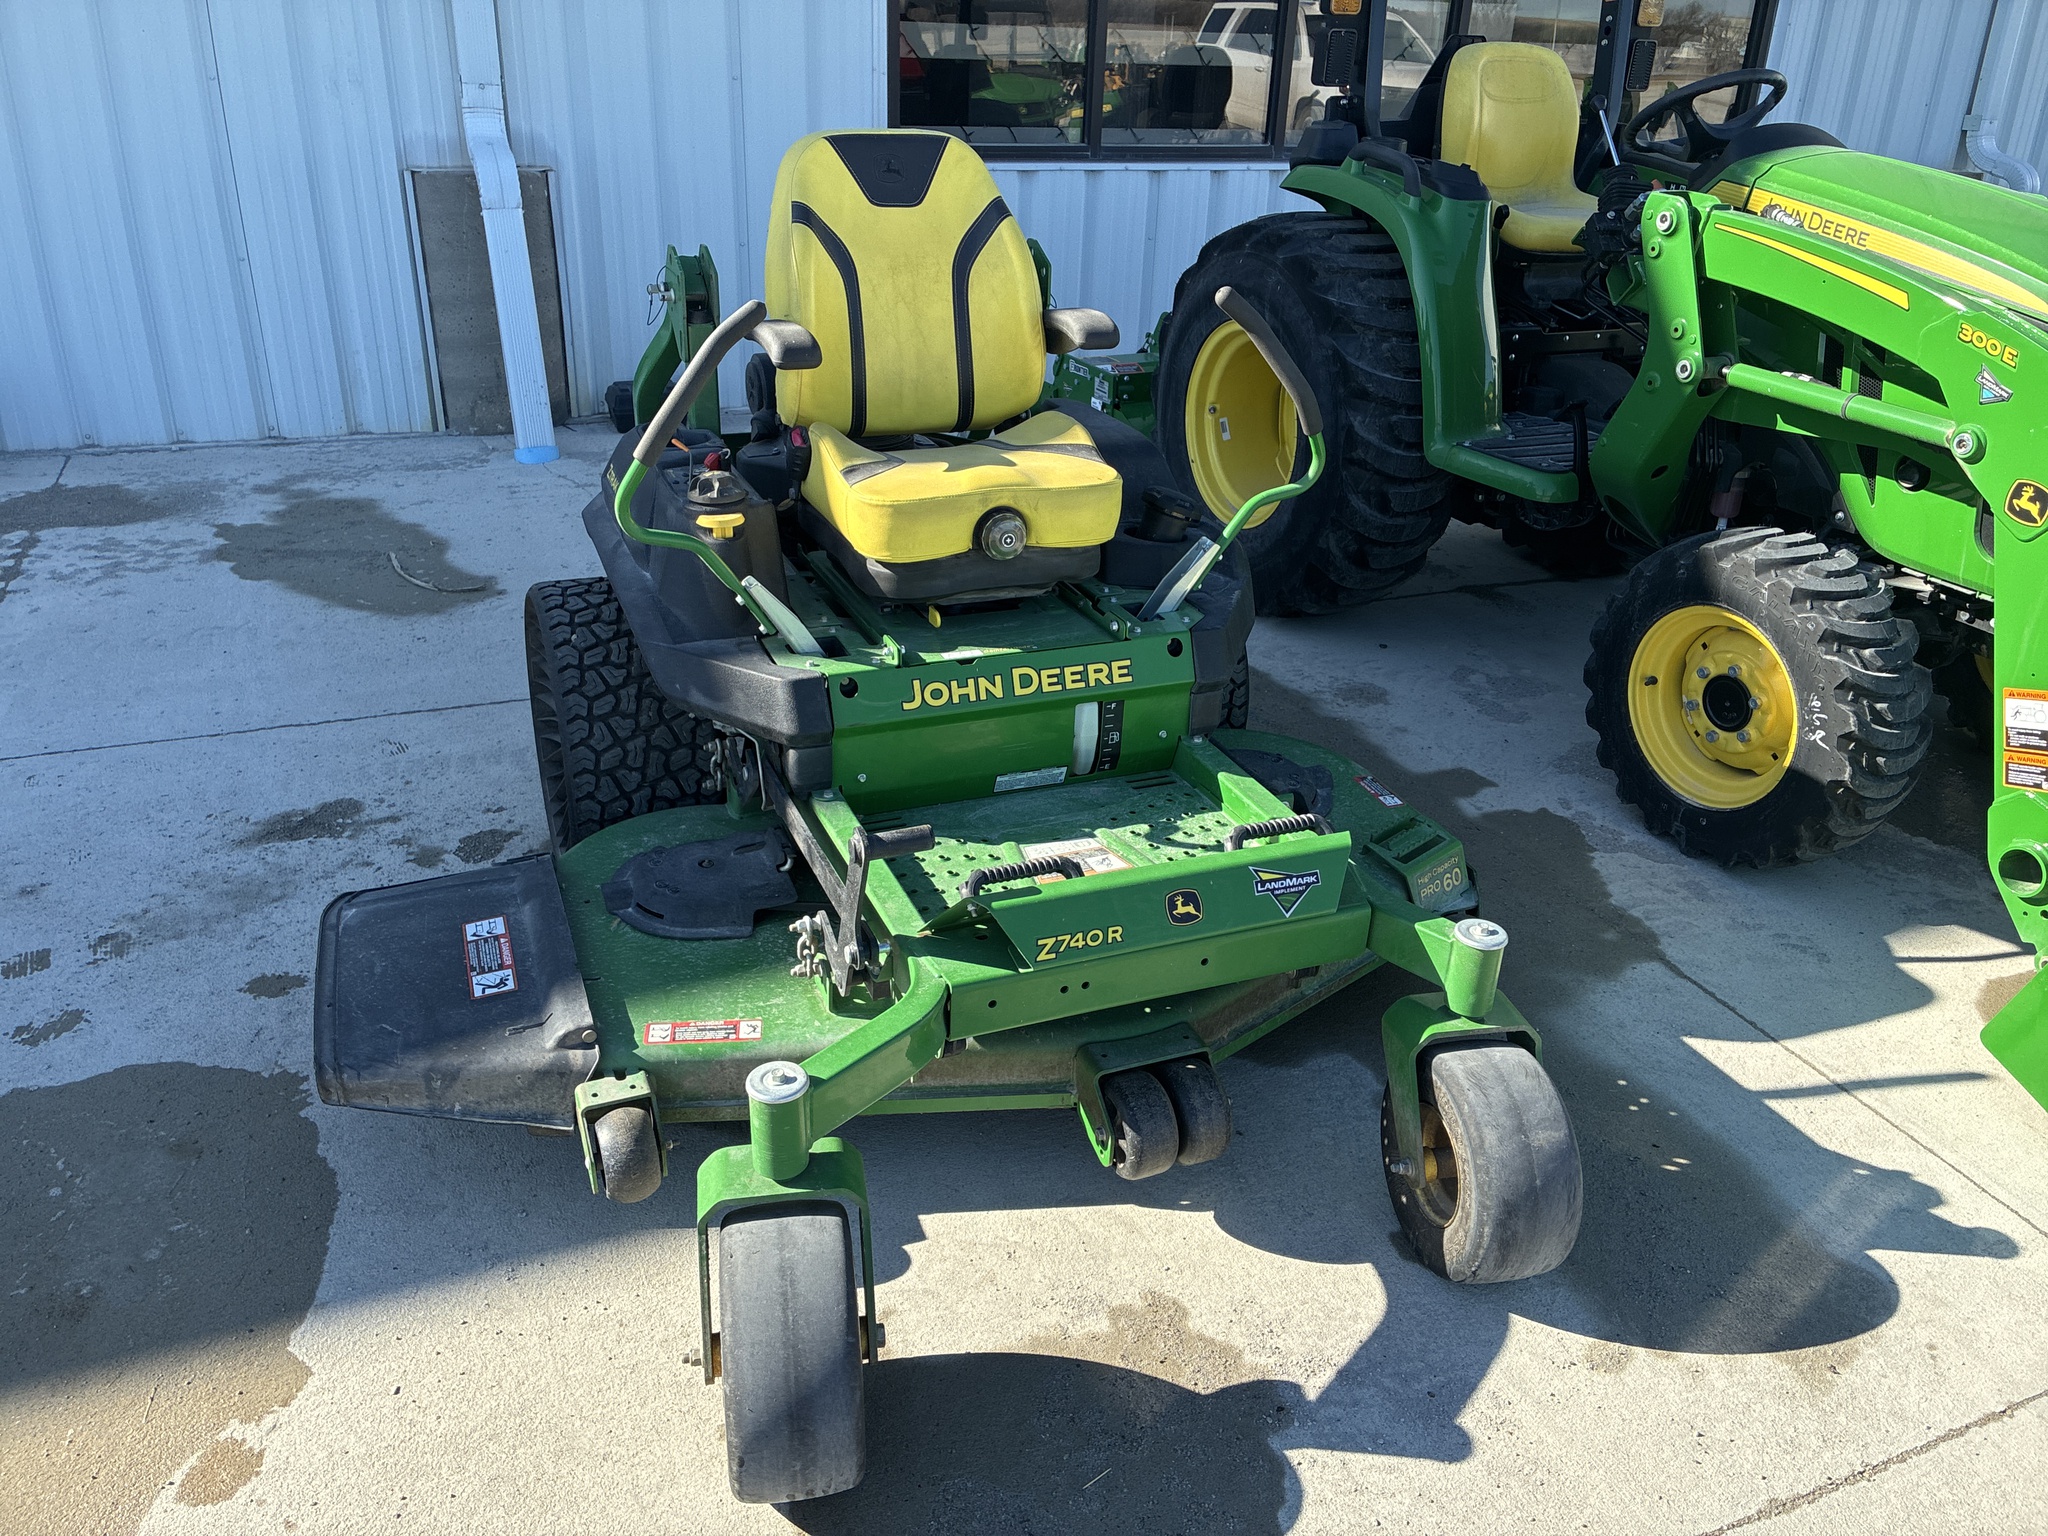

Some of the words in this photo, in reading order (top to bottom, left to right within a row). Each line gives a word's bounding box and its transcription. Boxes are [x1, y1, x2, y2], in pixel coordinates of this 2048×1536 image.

[1808, 211, 1871, 248] DEERE
[901, 673, 1004, 711] JOHN
[1011, 658, 1133, 697] DEERE
[2015, 691, 2047, 700] WARNING
[2016, 755, 2047, 765] WARNING
[1417, 872, 1433, 886] High
[1432, 855, 1459, 876] Capacity
[1420, 879, 1441, 901] PRO
[1443, 867, 1462, 892] 60
[1273, 885, 1306, 895] IMPLEMENT
